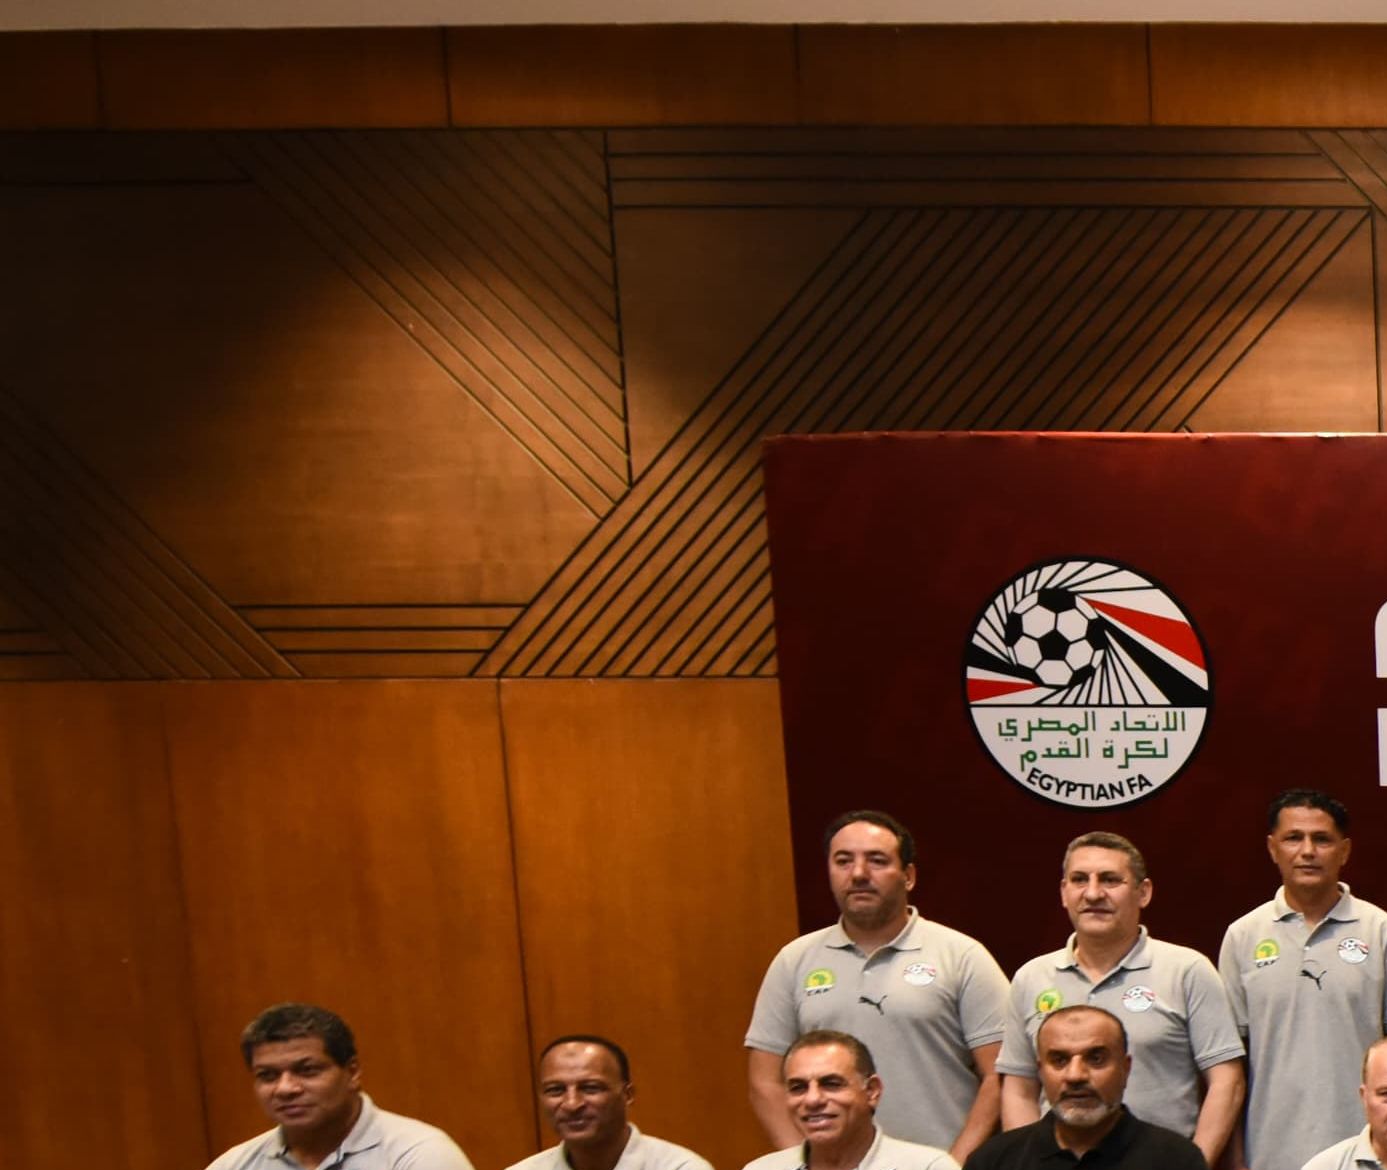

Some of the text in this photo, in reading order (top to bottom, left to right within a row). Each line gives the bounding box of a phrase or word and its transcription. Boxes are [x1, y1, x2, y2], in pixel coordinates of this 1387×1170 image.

[998, 710, 1186, 743] الاتحاد المصري
[1020, 737, 1169, 772] لكرة القدم
[1026, 767, 1152, 801] EGYPTIAN FA
[1256, 960, 1277, 969] CAF
